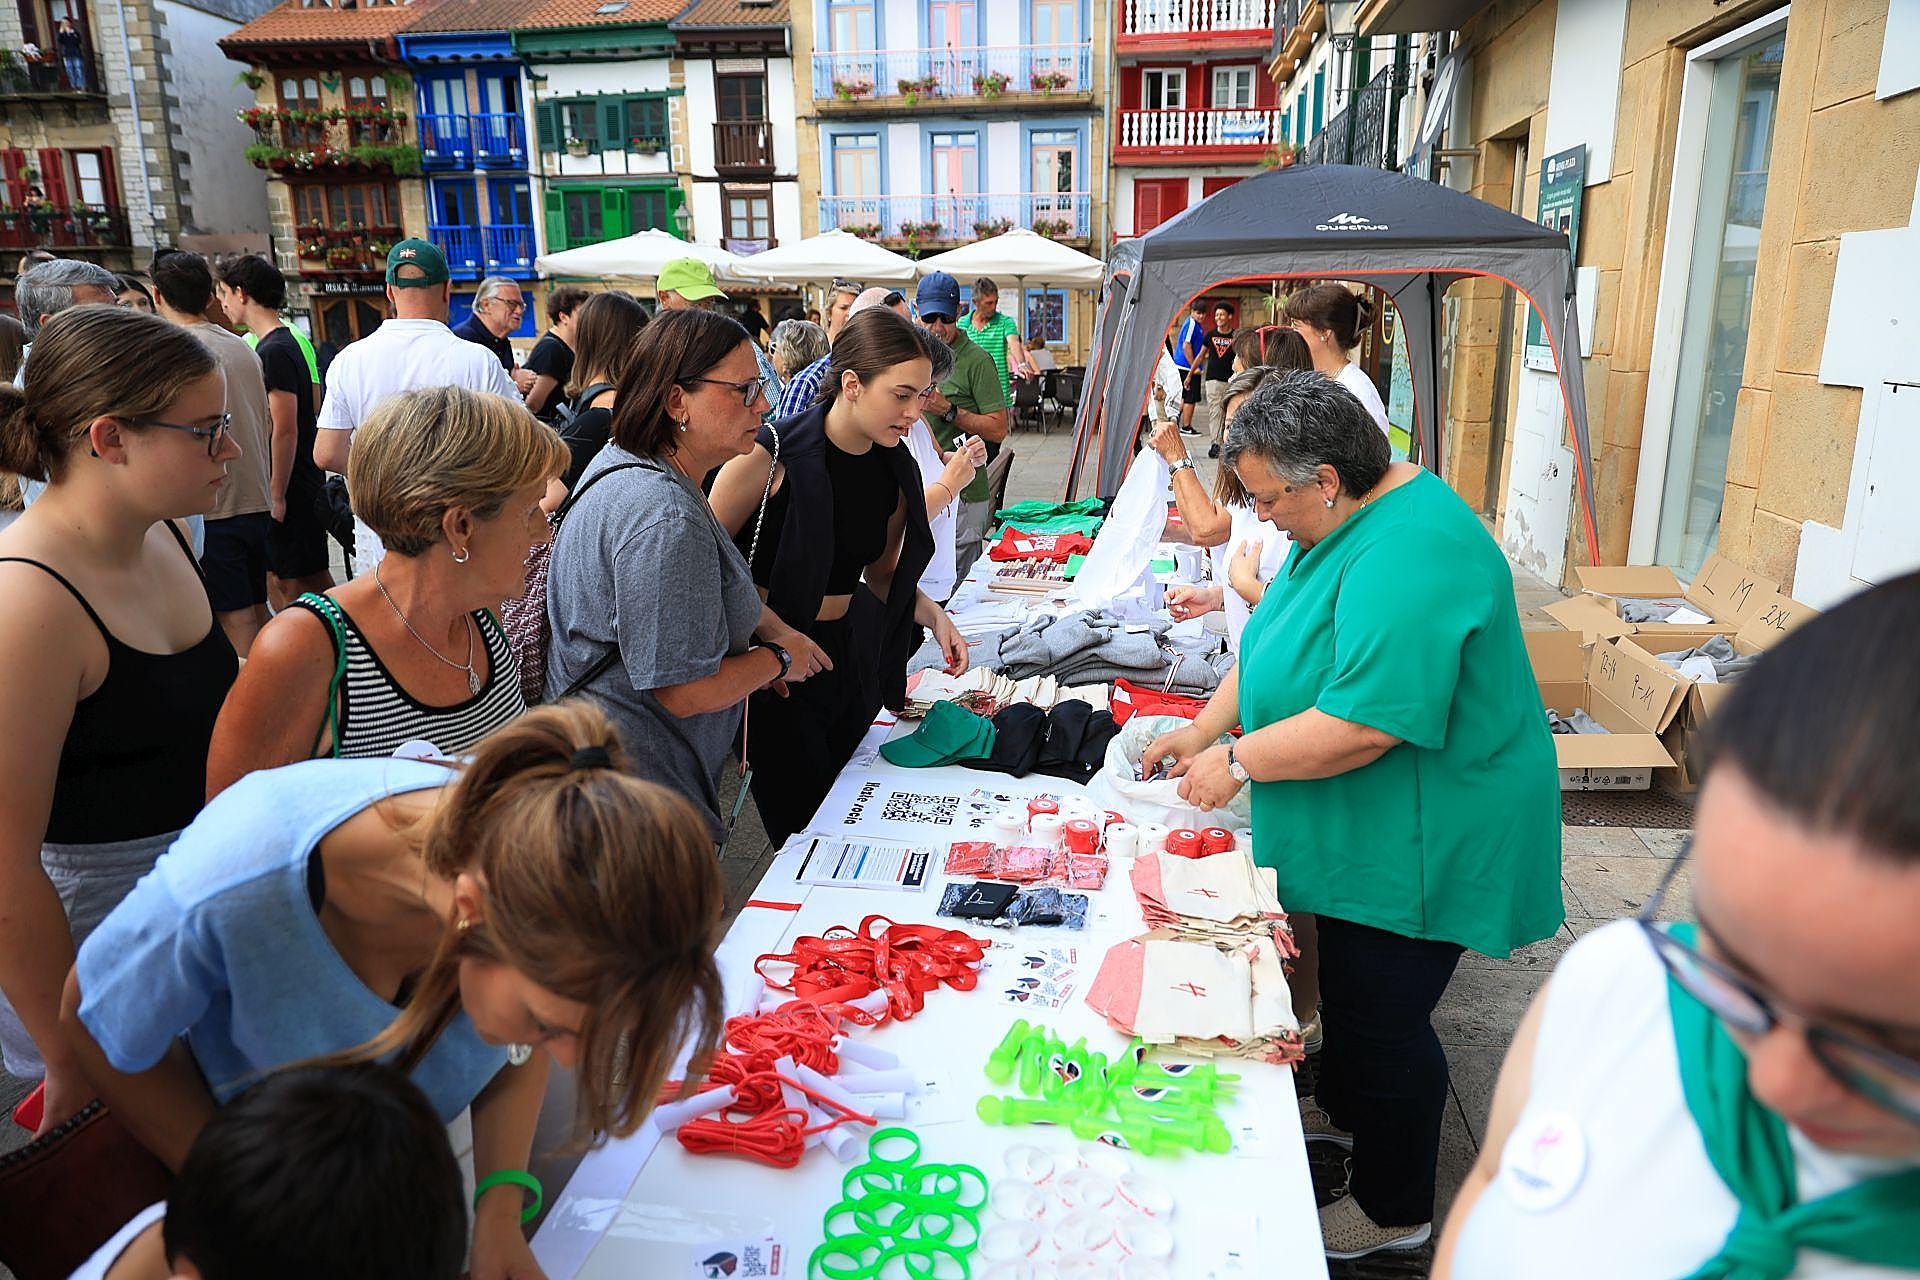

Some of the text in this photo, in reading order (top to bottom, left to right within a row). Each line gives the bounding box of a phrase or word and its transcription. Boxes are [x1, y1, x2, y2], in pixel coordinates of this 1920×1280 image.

[1315, 224, 1390, 232] Quechua
[1702, 562, 1754, 613] L M
[1759, 604, 1791, 631] 2XL
